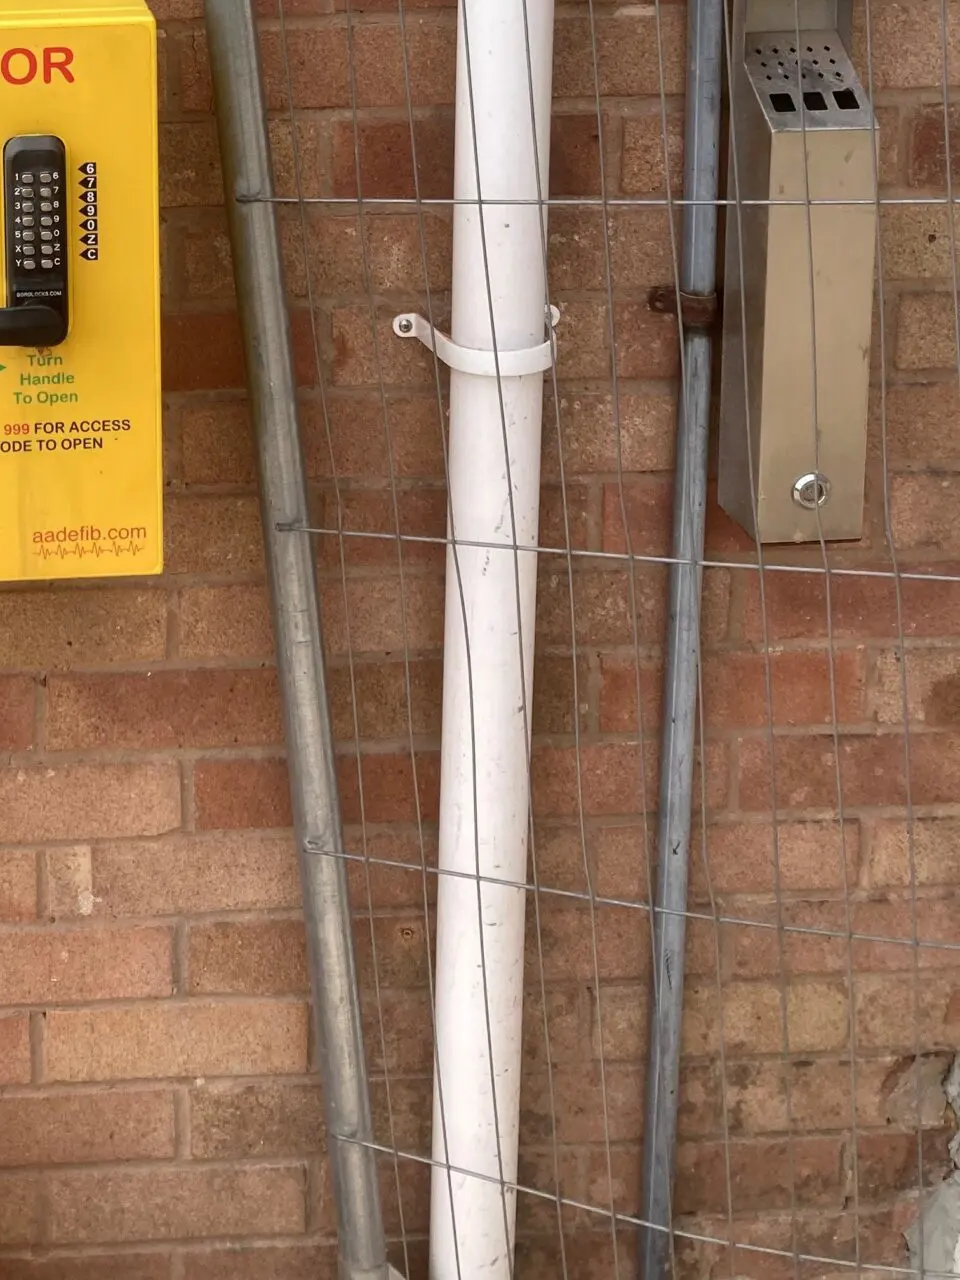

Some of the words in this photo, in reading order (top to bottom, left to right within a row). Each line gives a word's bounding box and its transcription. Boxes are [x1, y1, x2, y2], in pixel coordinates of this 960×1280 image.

[86, 163, 94, 174] 6
[87, 178, 95, 188] 7
[14, 188, 20, 196] 2
[53, 186, 59, 194] 7
[87, 192, 95, 202] 8
[15, 202, 21, 210] 3
[87, 206, 95, 216] 9
[15, 216, 21, 224] 4
[53, 215, 60, 223] 9
[87, 235, 96, 244] Z
[15, 245, 21, 253] X
[87, 249, 96, 259] C
[15, 259, 21, 267] Y
[54, 258, 60, 266] C
[26, 354, 63, 367] Turn
[20, 372, 75, 386] Handle
[13, 392, 32, 404] To
[36, 390, 78, 406] Open
[4, 423, 30, 436] 999
[34, 422, 65, 434] FOR
[69, 420, 131, 433] ACCESS
[36, 439, 57, 451] TO
[61, 438, 103, 450] OPEN
[32, 526, 146, 544] aadefib.com
